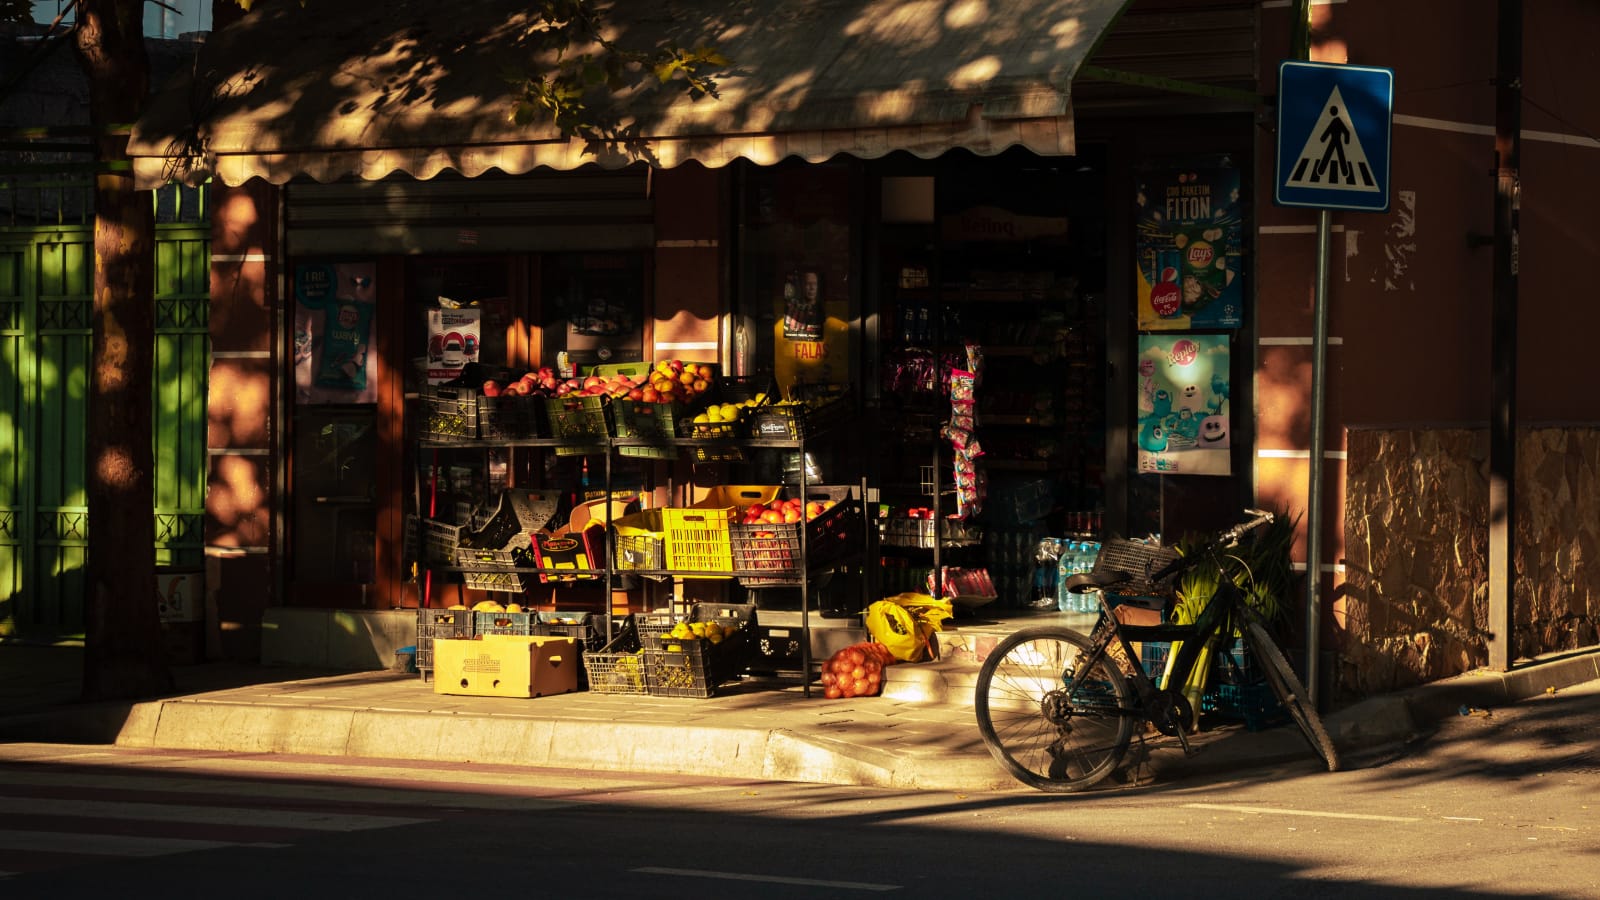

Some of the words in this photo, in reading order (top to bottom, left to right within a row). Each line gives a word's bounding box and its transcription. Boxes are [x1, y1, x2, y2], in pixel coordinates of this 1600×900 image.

[1166, 196, 1211, 222] FITON
[794, 342, 830, 359] FALAS
[1167, 341, 1201, 367] Replay
